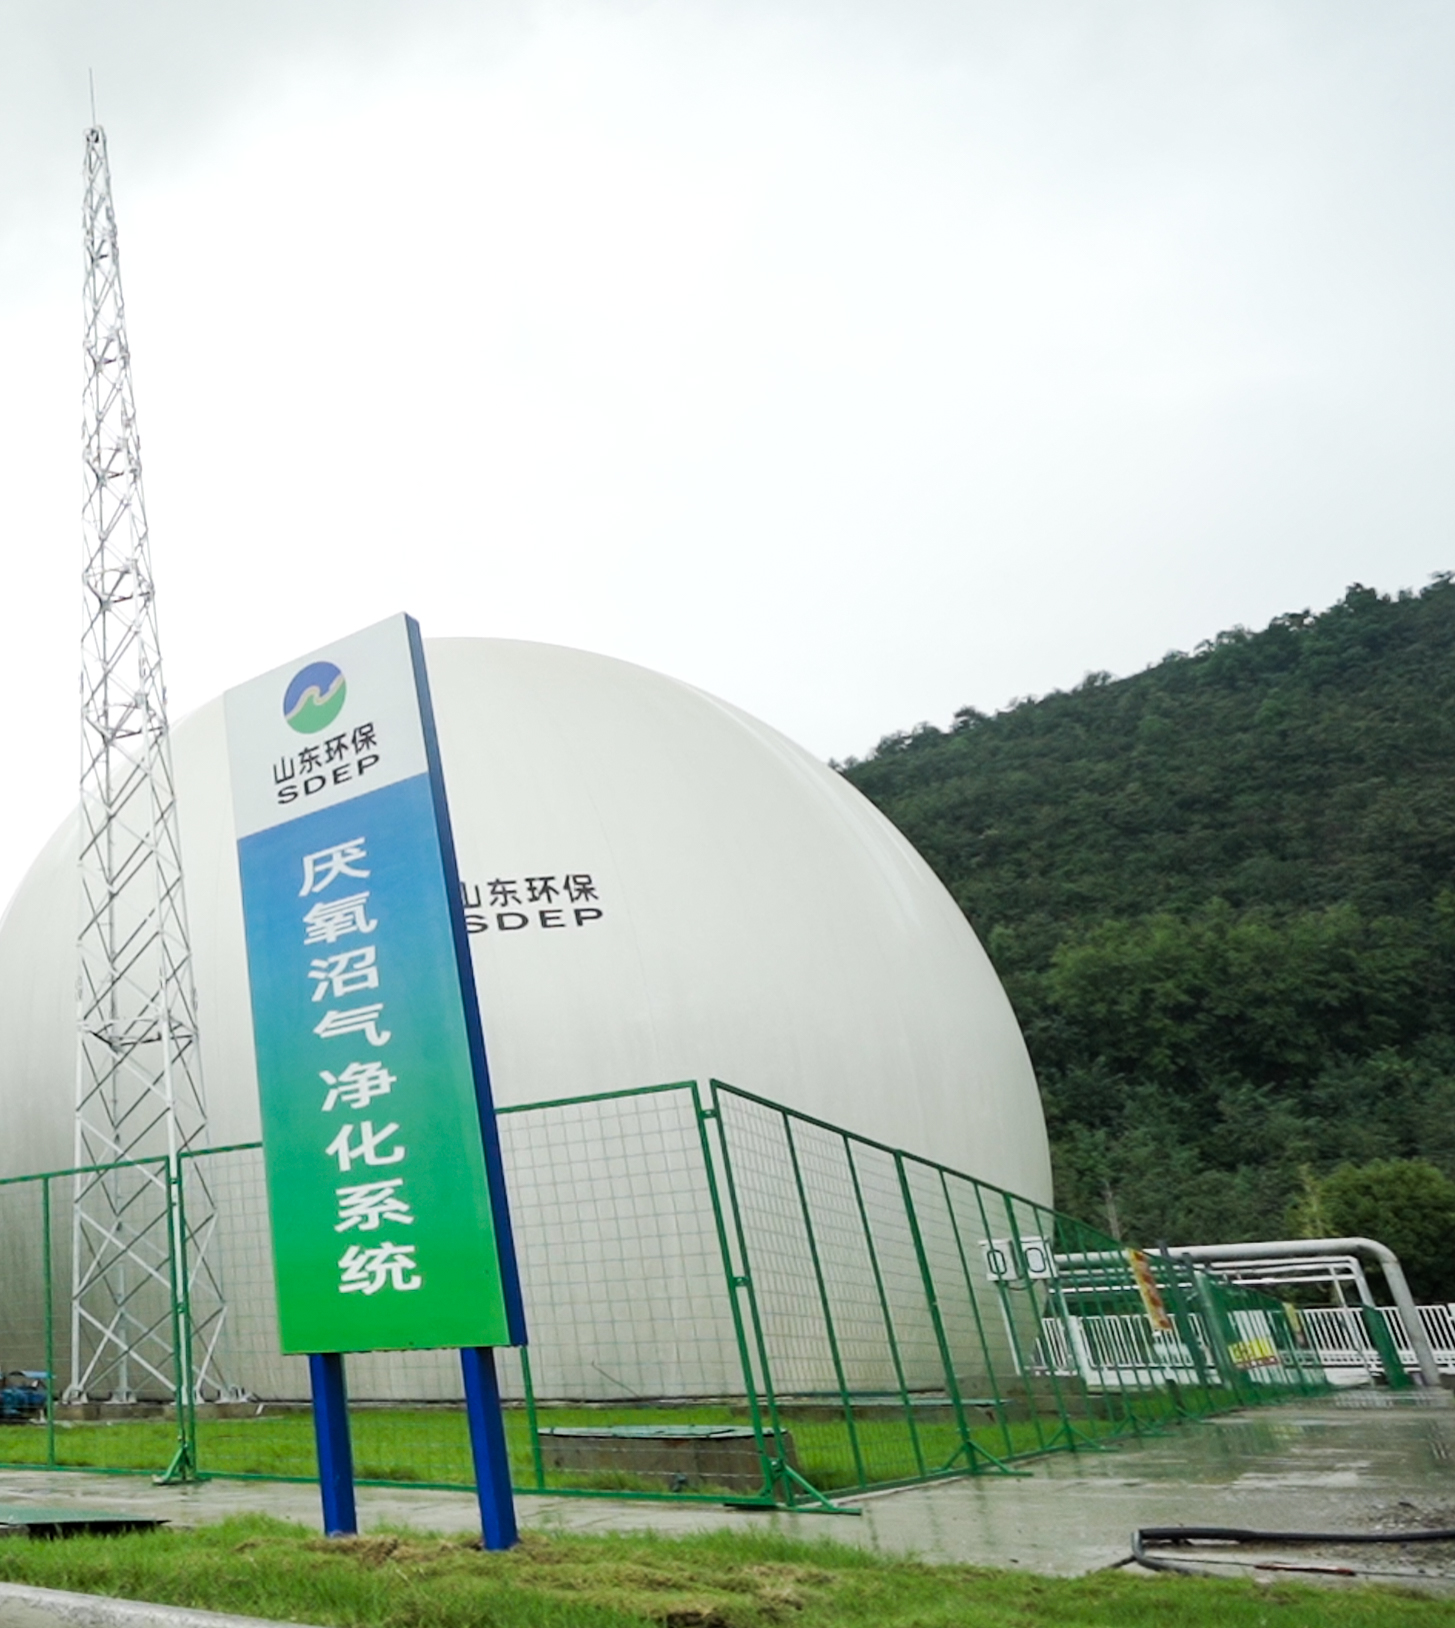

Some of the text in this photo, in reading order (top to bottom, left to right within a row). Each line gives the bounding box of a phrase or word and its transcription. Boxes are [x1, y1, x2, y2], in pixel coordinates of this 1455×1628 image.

[273, 721, 377, 785] 山东环保
[277, 754, 379, 804] SDEP
[460, 874, 599, 909] 山东环保
[465, 907, 603, 934] SDEP
[299, 837, 422, 1295] 厌氧沼气净化系统
